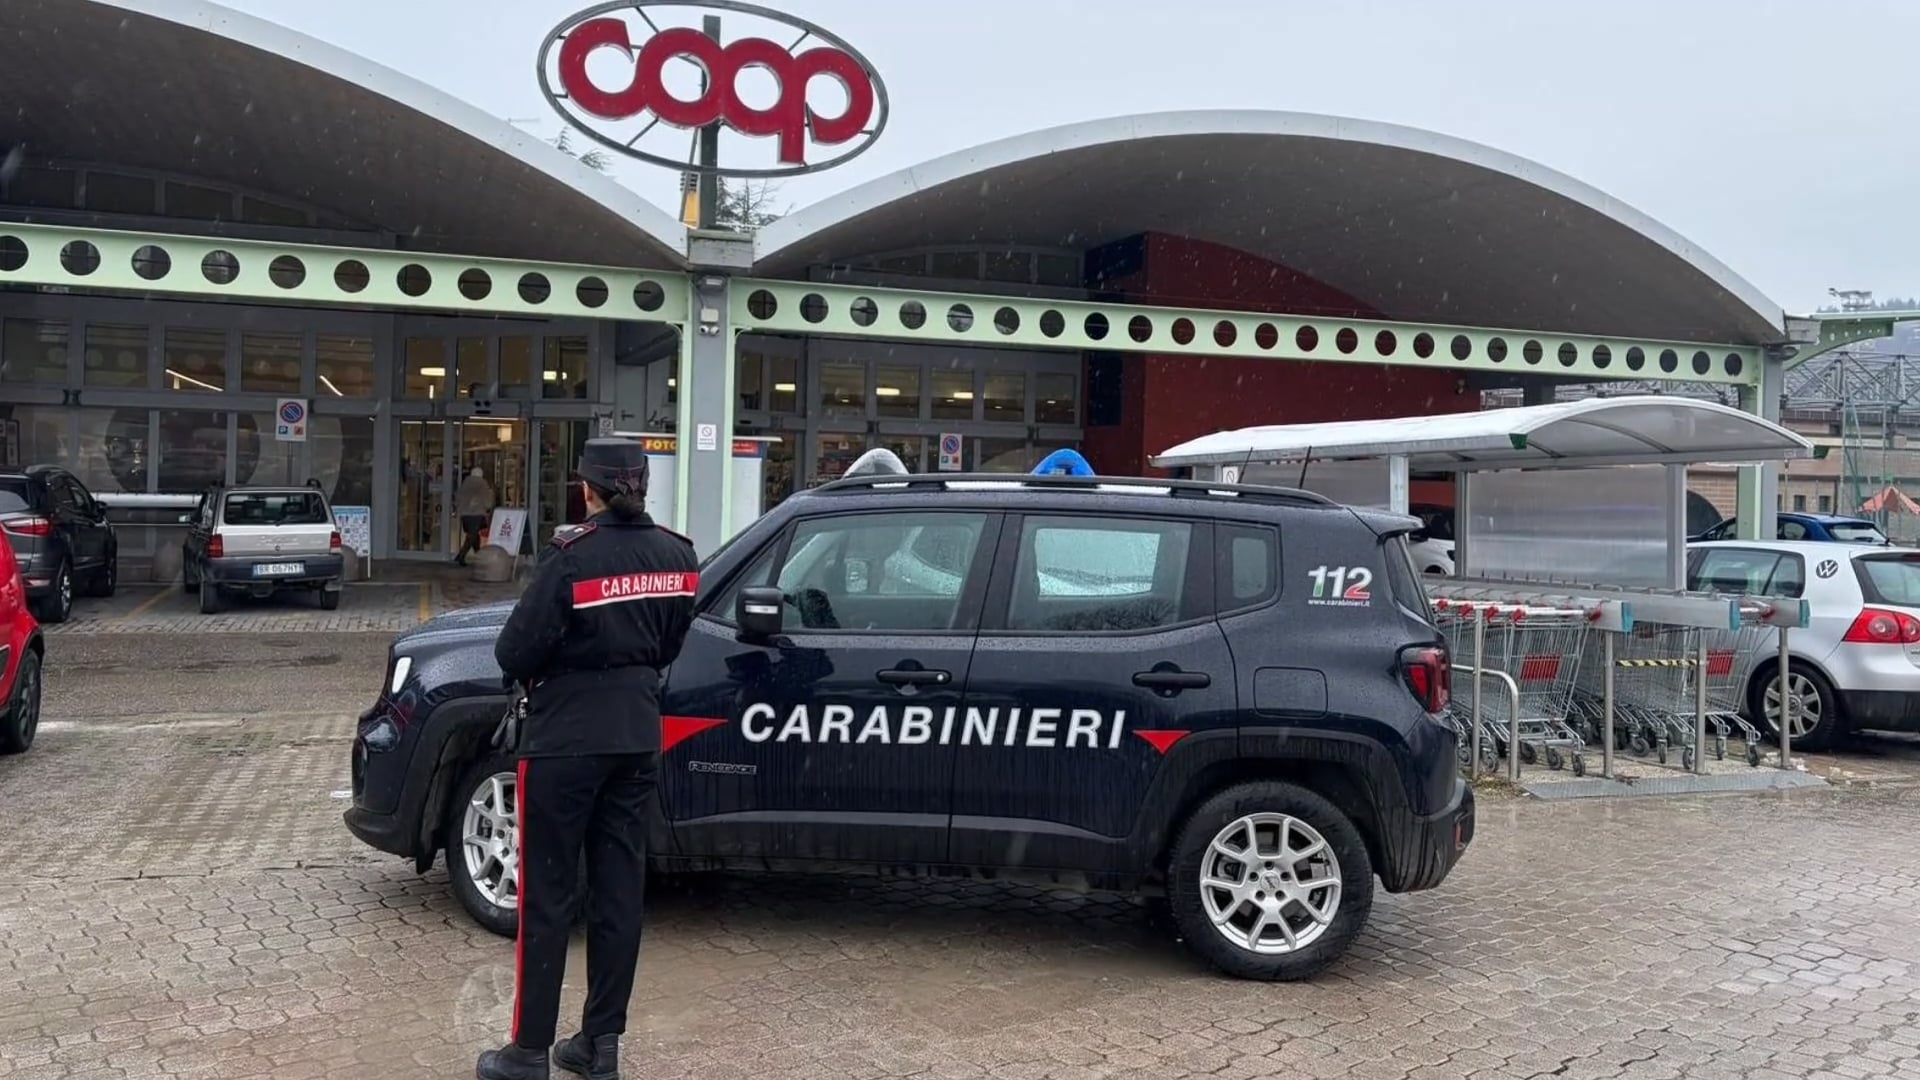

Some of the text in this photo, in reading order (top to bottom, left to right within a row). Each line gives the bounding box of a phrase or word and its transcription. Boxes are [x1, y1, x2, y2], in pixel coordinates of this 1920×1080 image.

[558, 16, 874, 165] coop
[601, 574, 684, 597] CARABINIERI
[1307, 565, 1373, 599] 112
[740, 702, 1126, 749] CARABINIERI
[688, 760, 757, 775] RENEGADE
